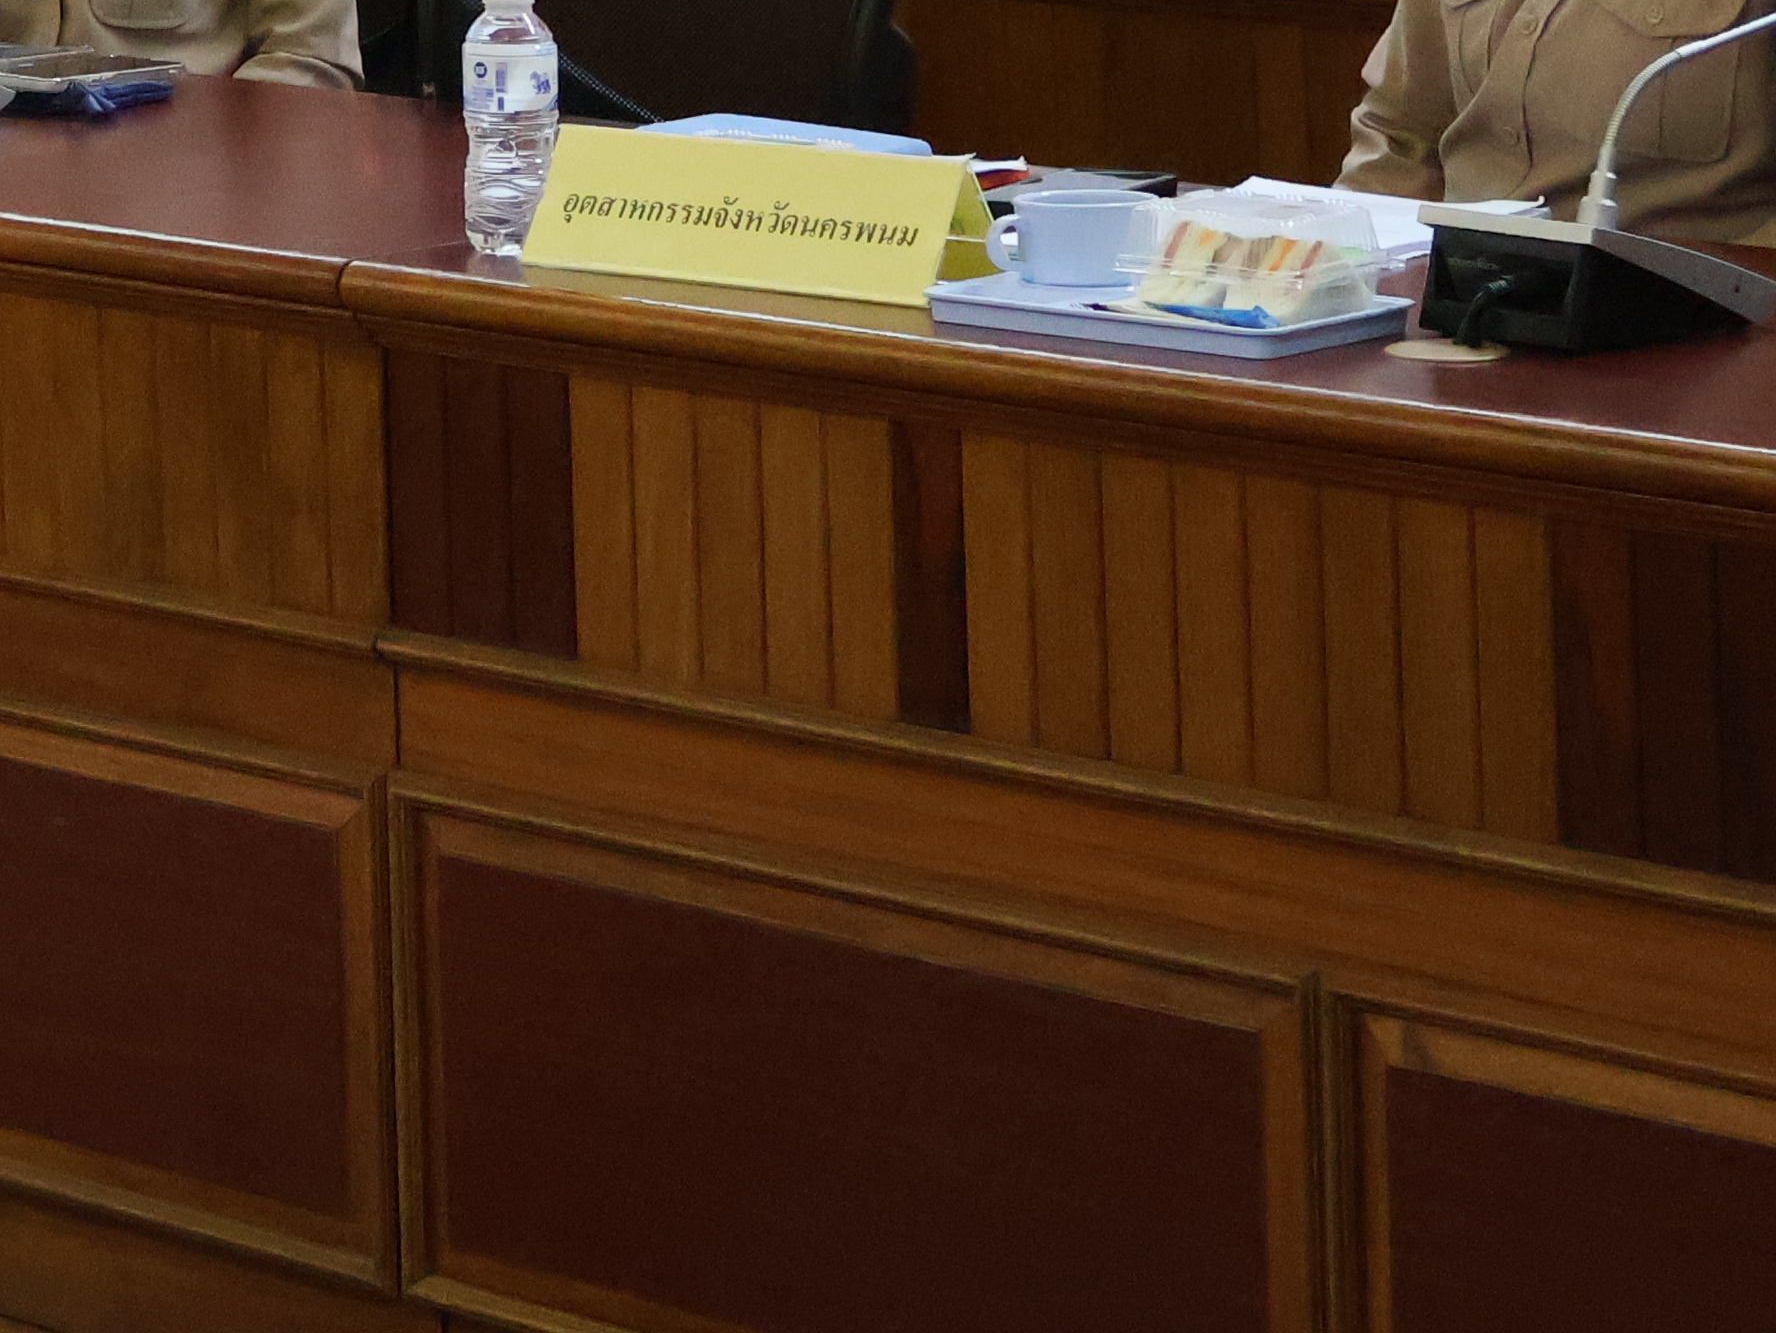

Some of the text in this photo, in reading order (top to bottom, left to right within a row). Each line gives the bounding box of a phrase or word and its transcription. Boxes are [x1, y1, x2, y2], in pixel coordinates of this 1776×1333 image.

[562, 191, 919, 247] อุตสาหกรรมจังหวัดนครพนม
